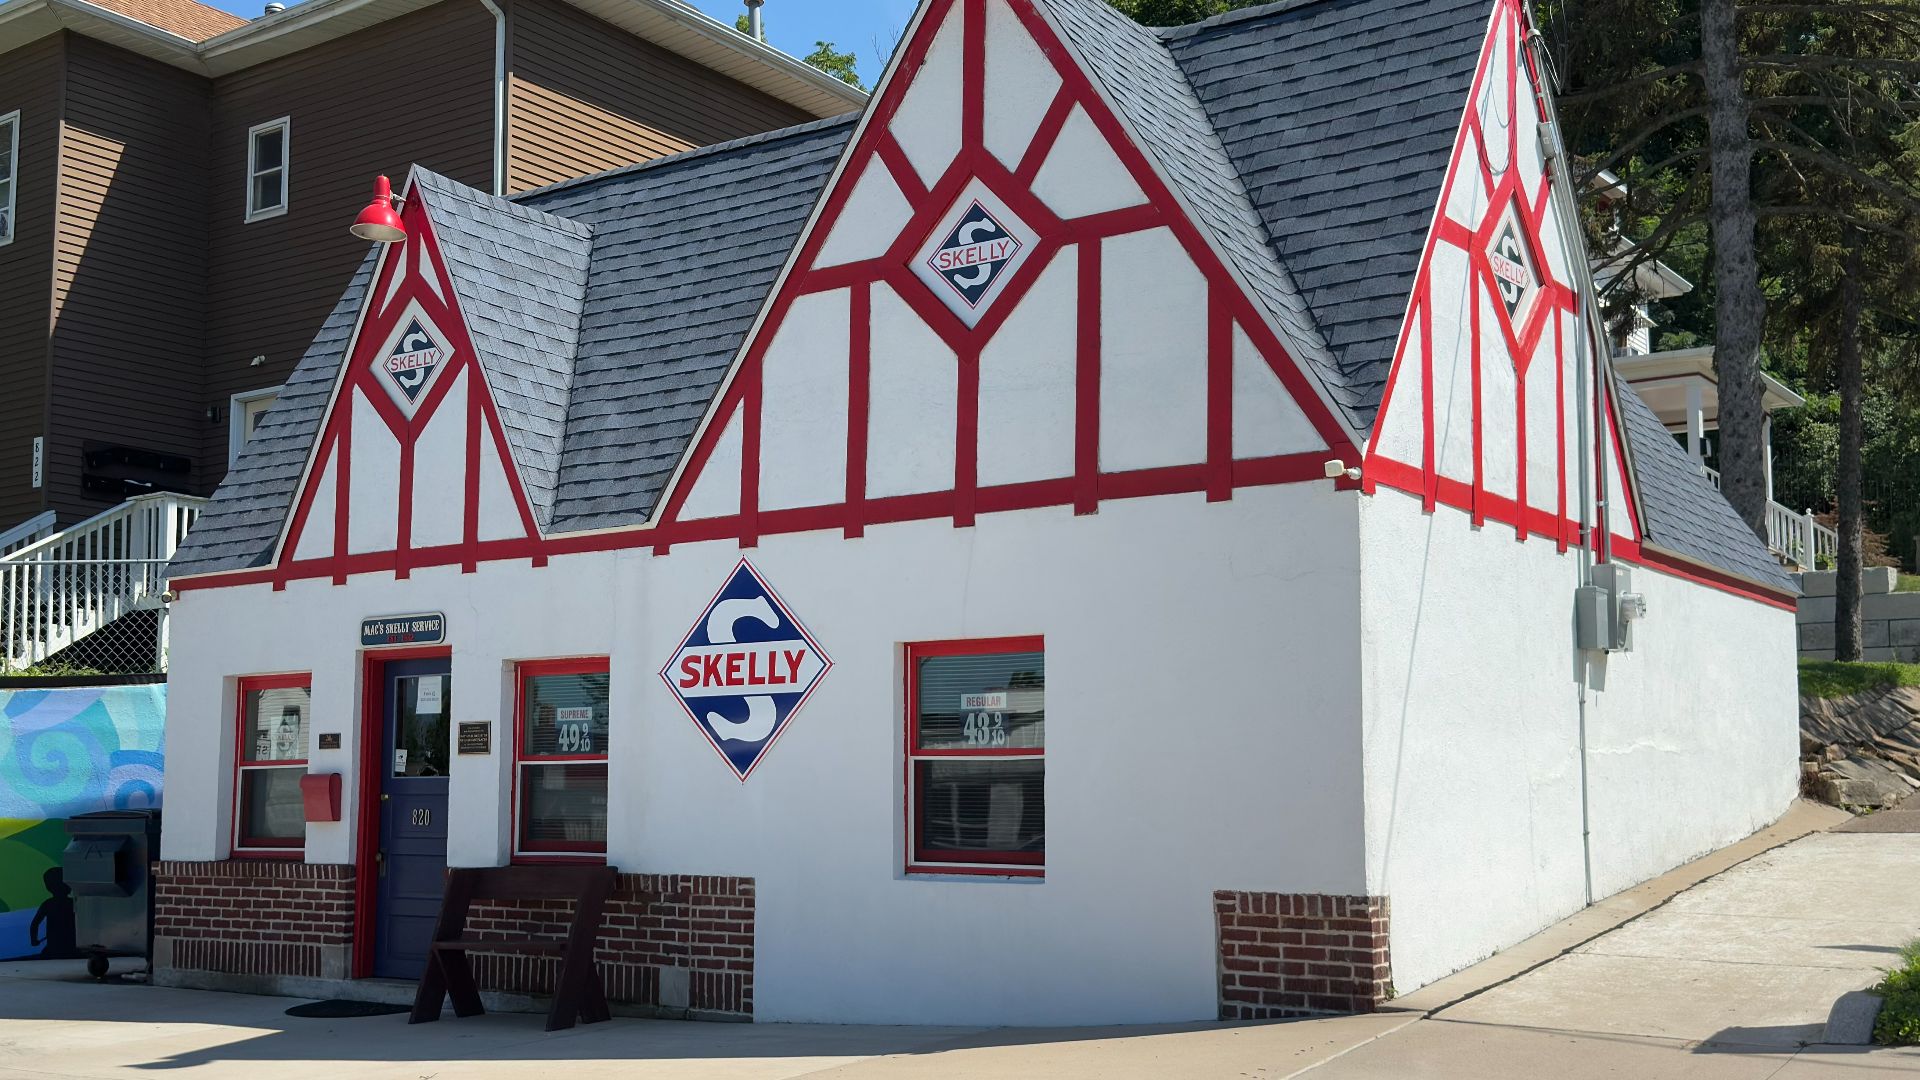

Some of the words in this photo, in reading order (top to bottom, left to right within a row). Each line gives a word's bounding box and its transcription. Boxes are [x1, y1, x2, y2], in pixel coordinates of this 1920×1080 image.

[939, 240, 1010, 269] SKELLY
[1493, 255, 1525, 285] SKELLY
[390, 349, 437, 372] SKELLY
[363, 621, 384, 636] MAC'S
[385, 621, 410, 634] SKELLY
[411, 619, 440, 633] SERVICE
[679, 649, 806, 689] SKELLY
[560, 709, 589, 719] SUPREME
[966, 695, 1001, 707] REGULAR
[558, 723, 580, 752] 49
[963, 712, 990, 745] 43
[412, 808, 430, 826] 820
